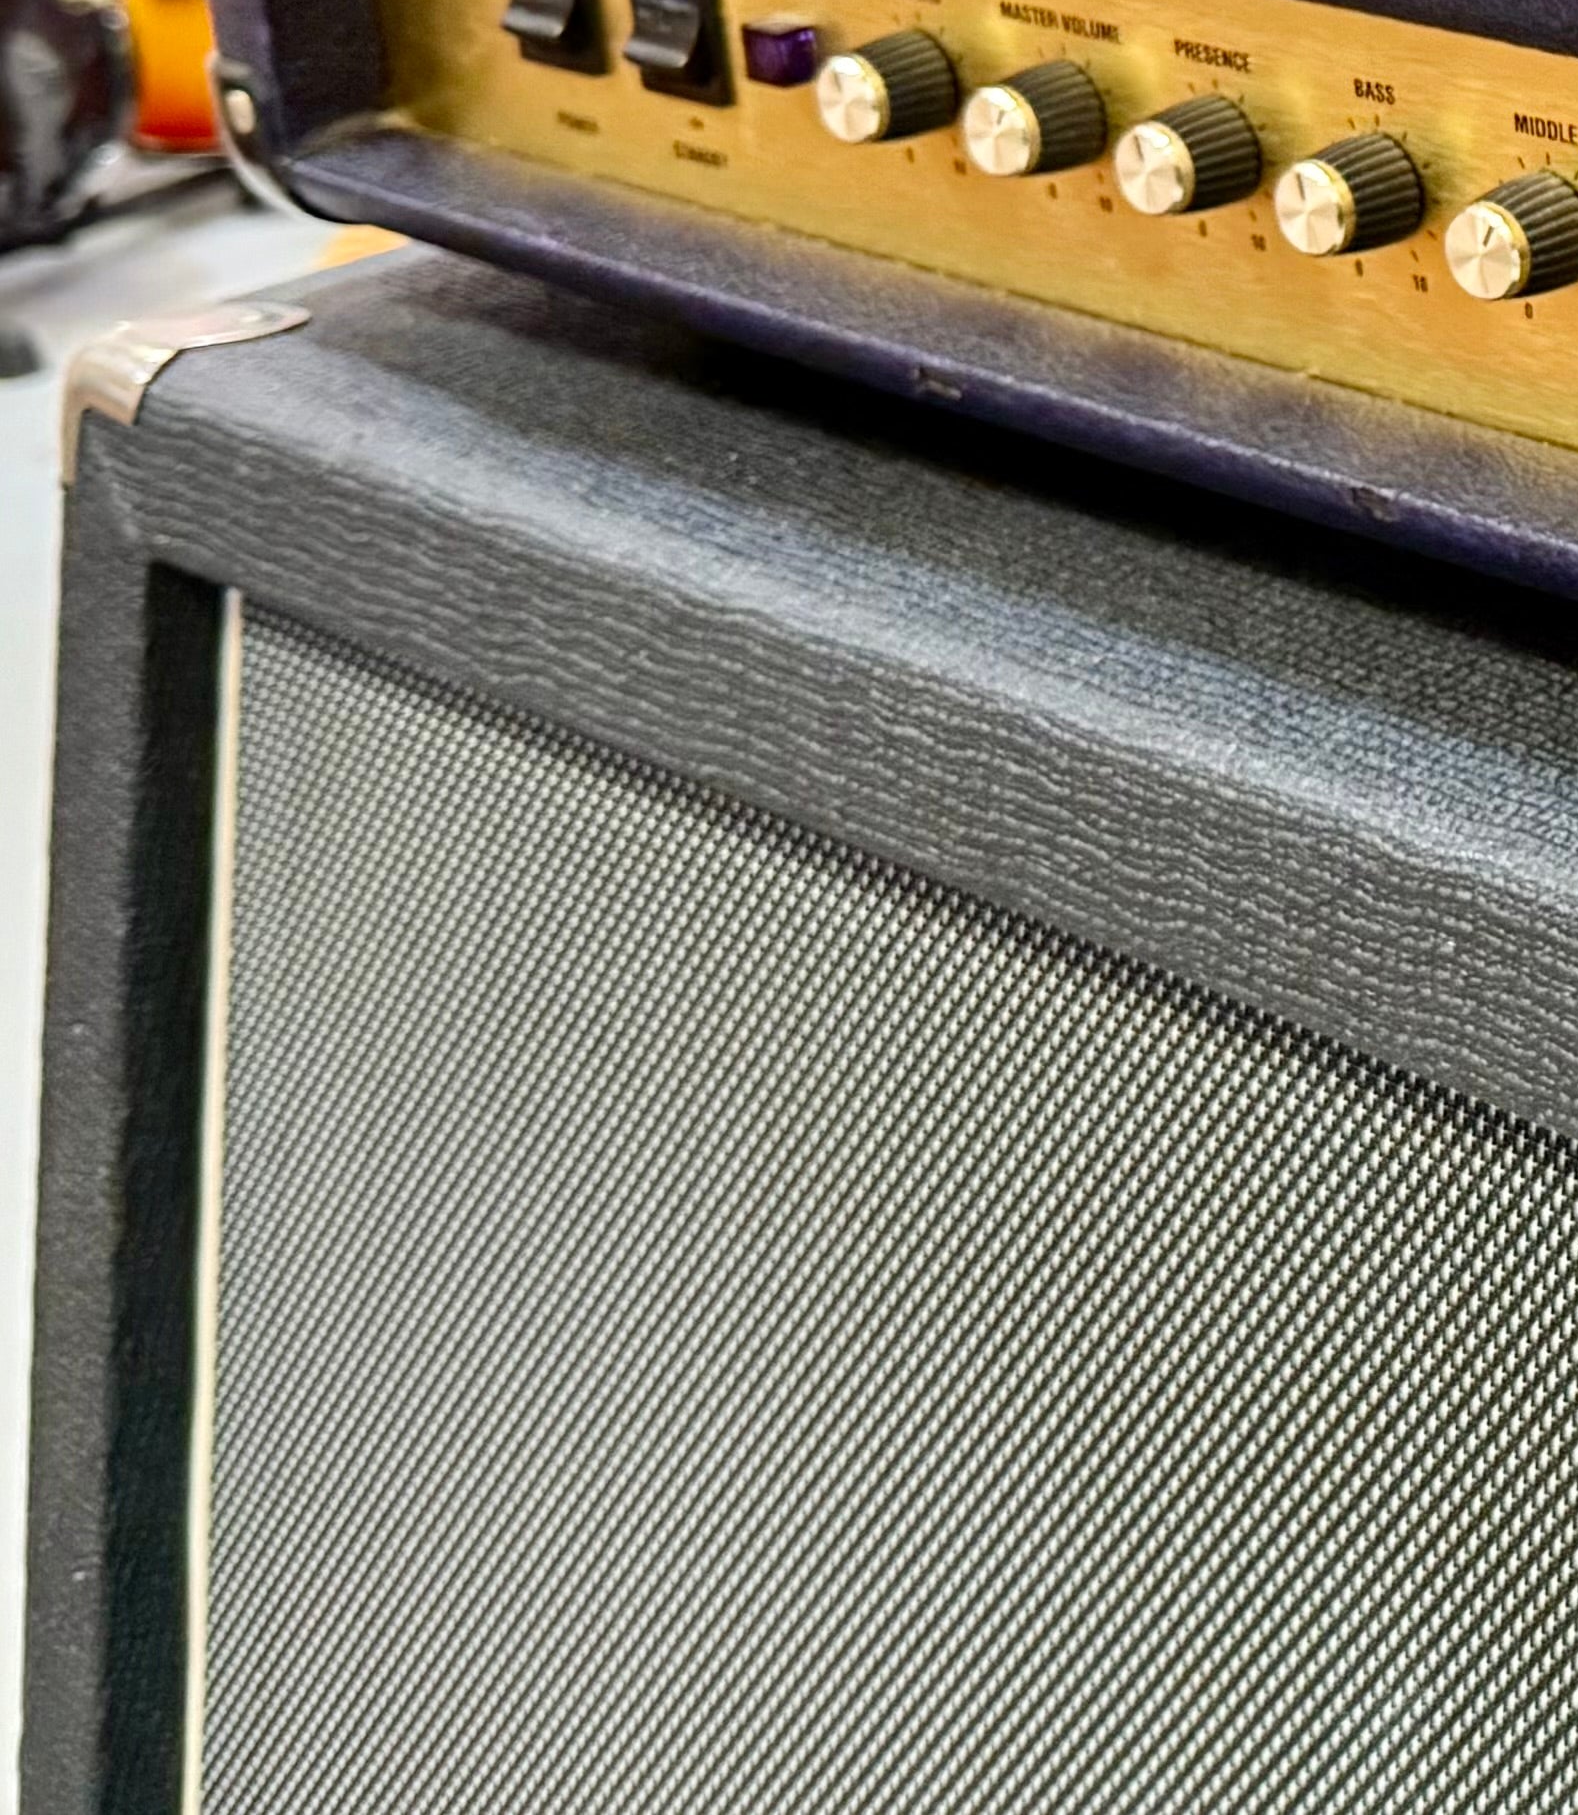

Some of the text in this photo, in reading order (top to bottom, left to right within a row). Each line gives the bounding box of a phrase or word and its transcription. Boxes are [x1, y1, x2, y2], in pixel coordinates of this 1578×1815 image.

[1000, 0, 1122, 44] MASTER VOLUME
[1173, 38, 1252, 73] PRESENCE
[1353, 78, 1395, 106] BASS
[1513, 113, 1578, 146] MIDDLE
[1412, 273, 1429, 293] 10
[1525, 301, 1534, 319] 0
